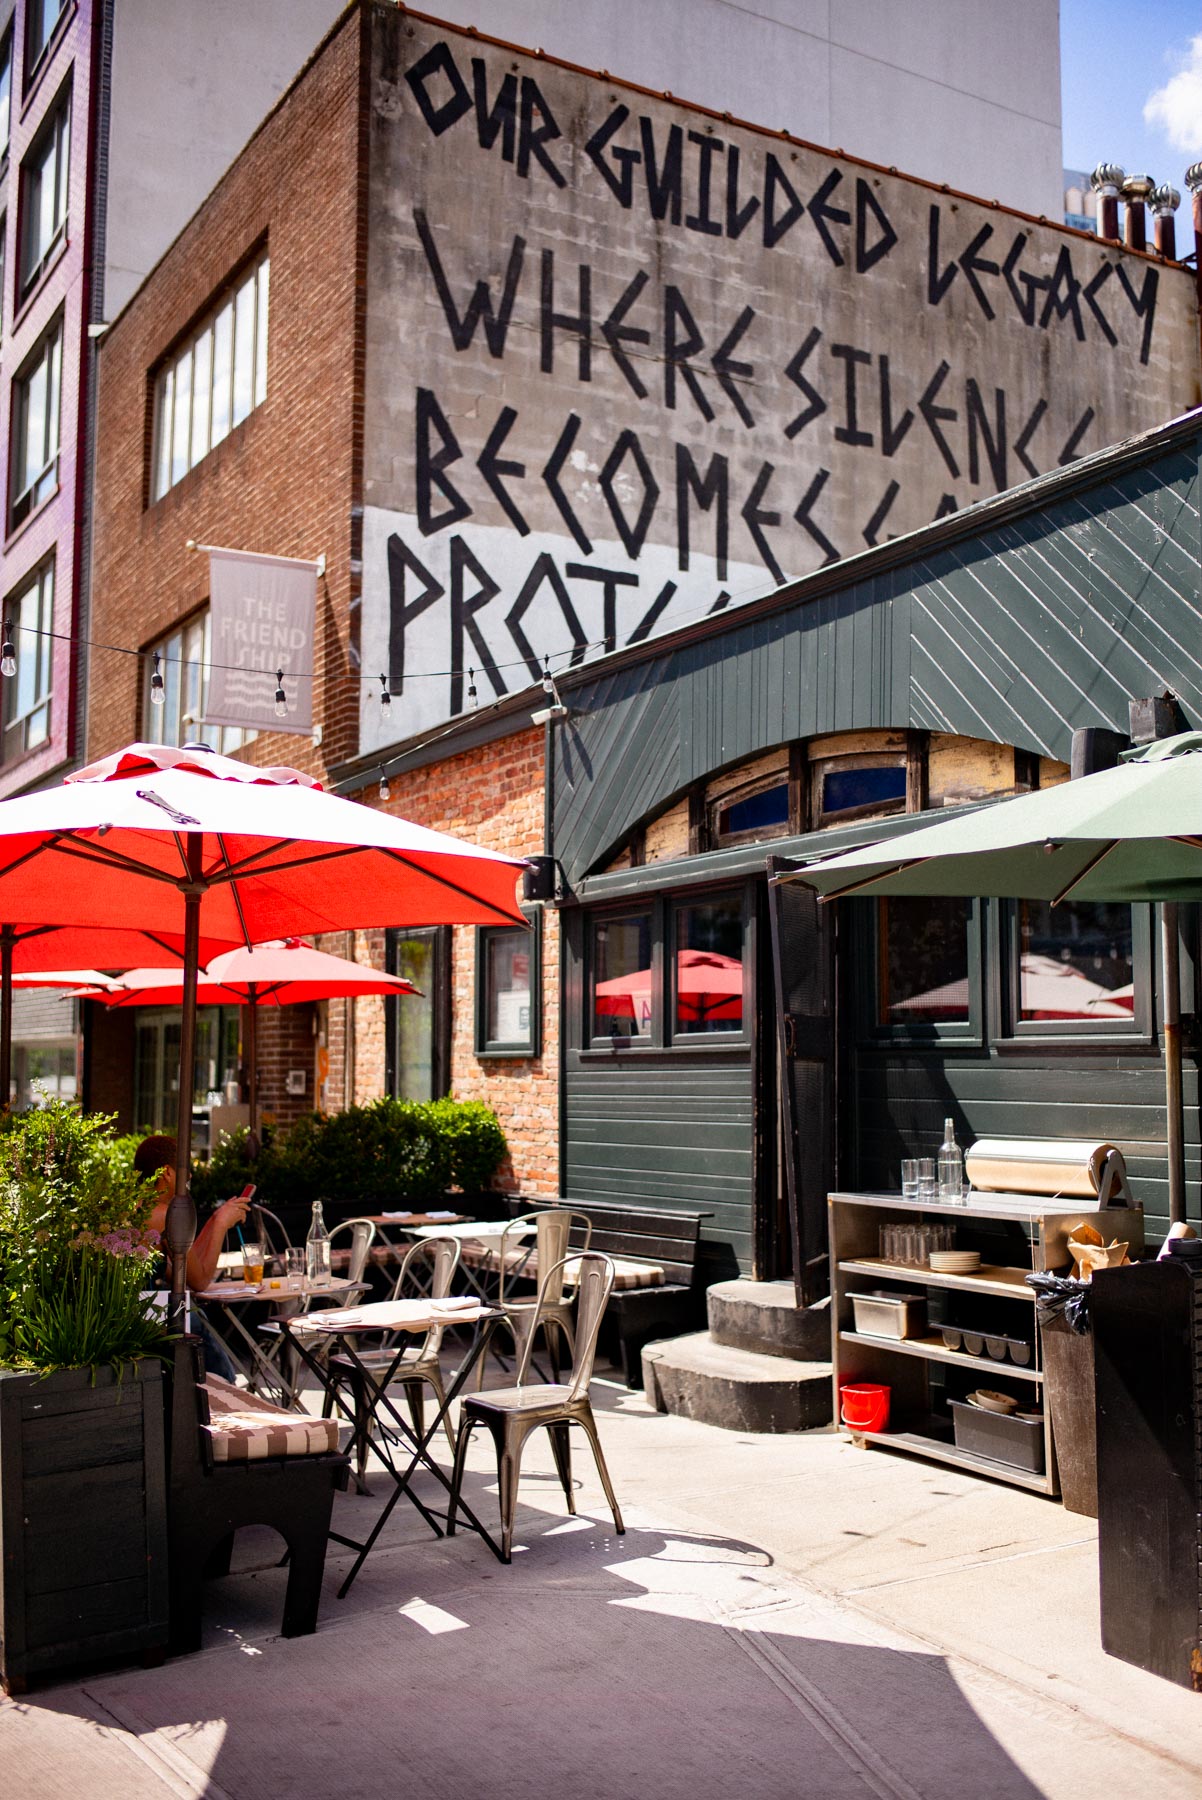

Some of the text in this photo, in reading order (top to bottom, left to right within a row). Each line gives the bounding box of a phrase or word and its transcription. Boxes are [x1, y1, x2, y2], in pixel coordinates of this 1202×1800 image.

[404, 42, 1159, 365] OUR GUILDED LEGACY
[413, 208, 755, 428] WHERE
[416, 386, 841, 586] BECOMES
[220, 617, 307, 649] FRIEND
[236, 647, 292, 670] SHIP
[243, 597, 287, 622] THE
